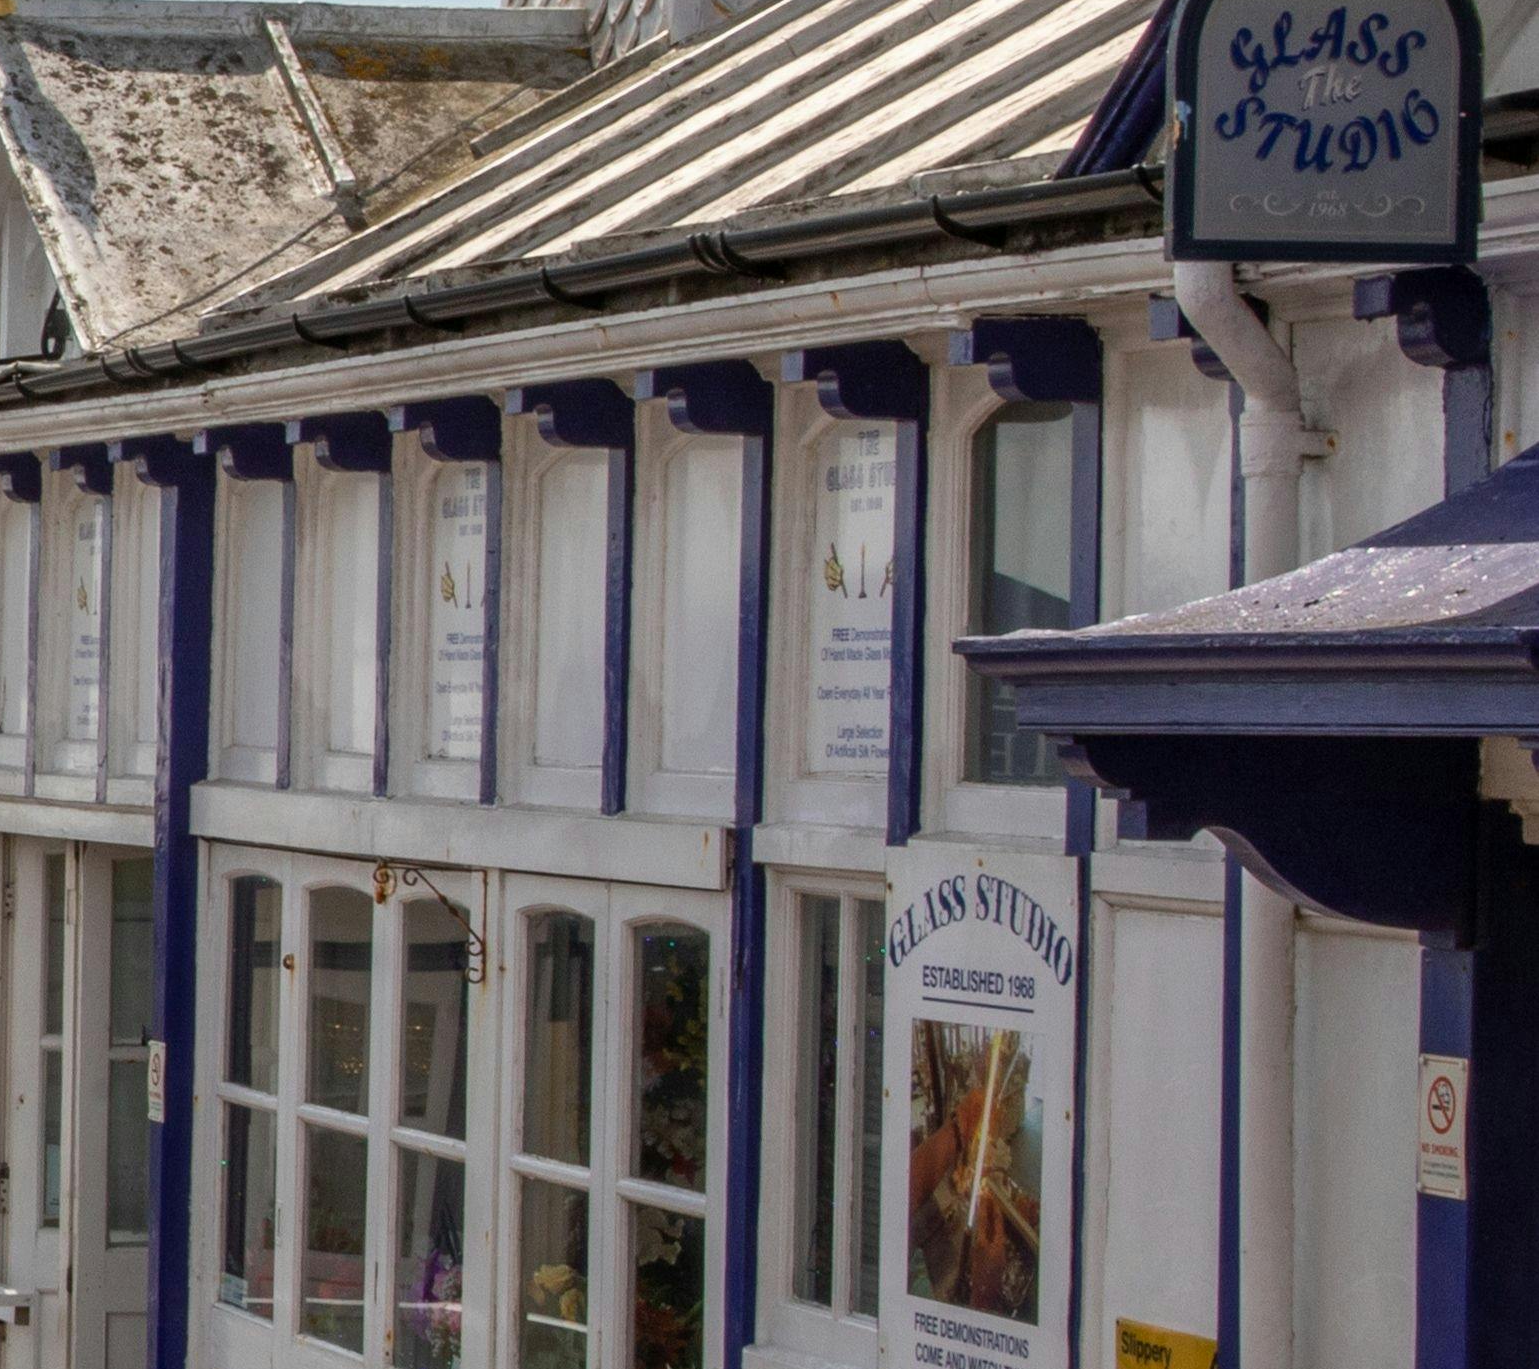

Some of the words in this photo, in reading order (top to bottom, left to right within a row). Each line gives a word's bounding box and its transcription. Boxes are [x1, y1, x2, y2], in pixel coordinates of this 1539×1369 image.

[1230, 6, 1427, 93] GLASS
[1298, 64, 1362, 111] The
[1215, 89, 1439, 173] STUDIO
[889, 874, 966, 967] GLASS
[976, 873, 1072, 986] STUDIO
[922, 965, 1004, 994] ESTABLISHED
[1008, 975, 1035, 998] 1968
[914, 1312, 938, 1336] FREE
[940, 1319, 1030, 1359] DEMONSTRATIONS
[915, 1343, 943, 1367] COME
[1122, 1331, 1172, 1369] Slippery
